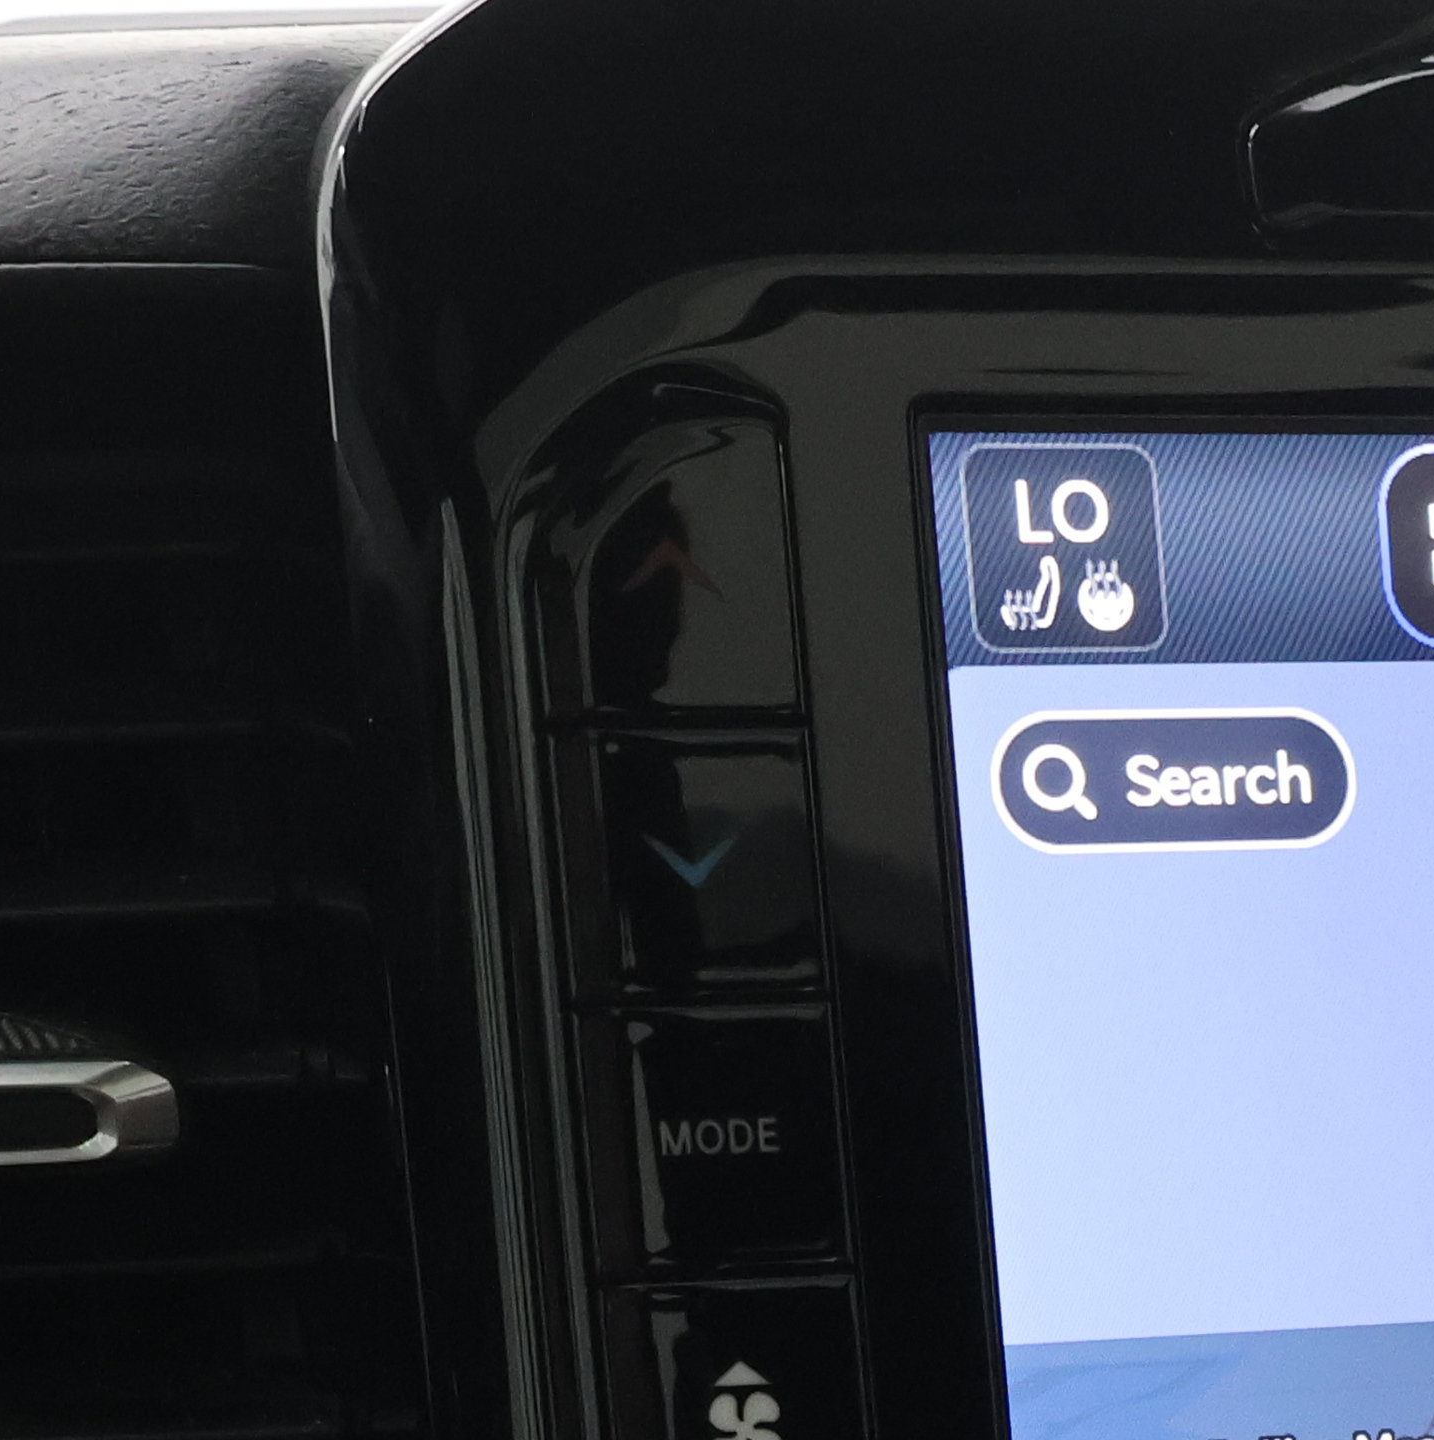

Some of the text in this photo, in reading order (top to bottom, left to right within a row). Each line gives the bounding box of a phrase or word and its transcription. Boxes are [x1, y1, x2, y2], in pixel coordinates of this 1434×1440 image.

[1014, 478, 1110, 544] LO
[1125, 748, 1314, 808] Search
[658, 1117, 781, 1156] MODE
